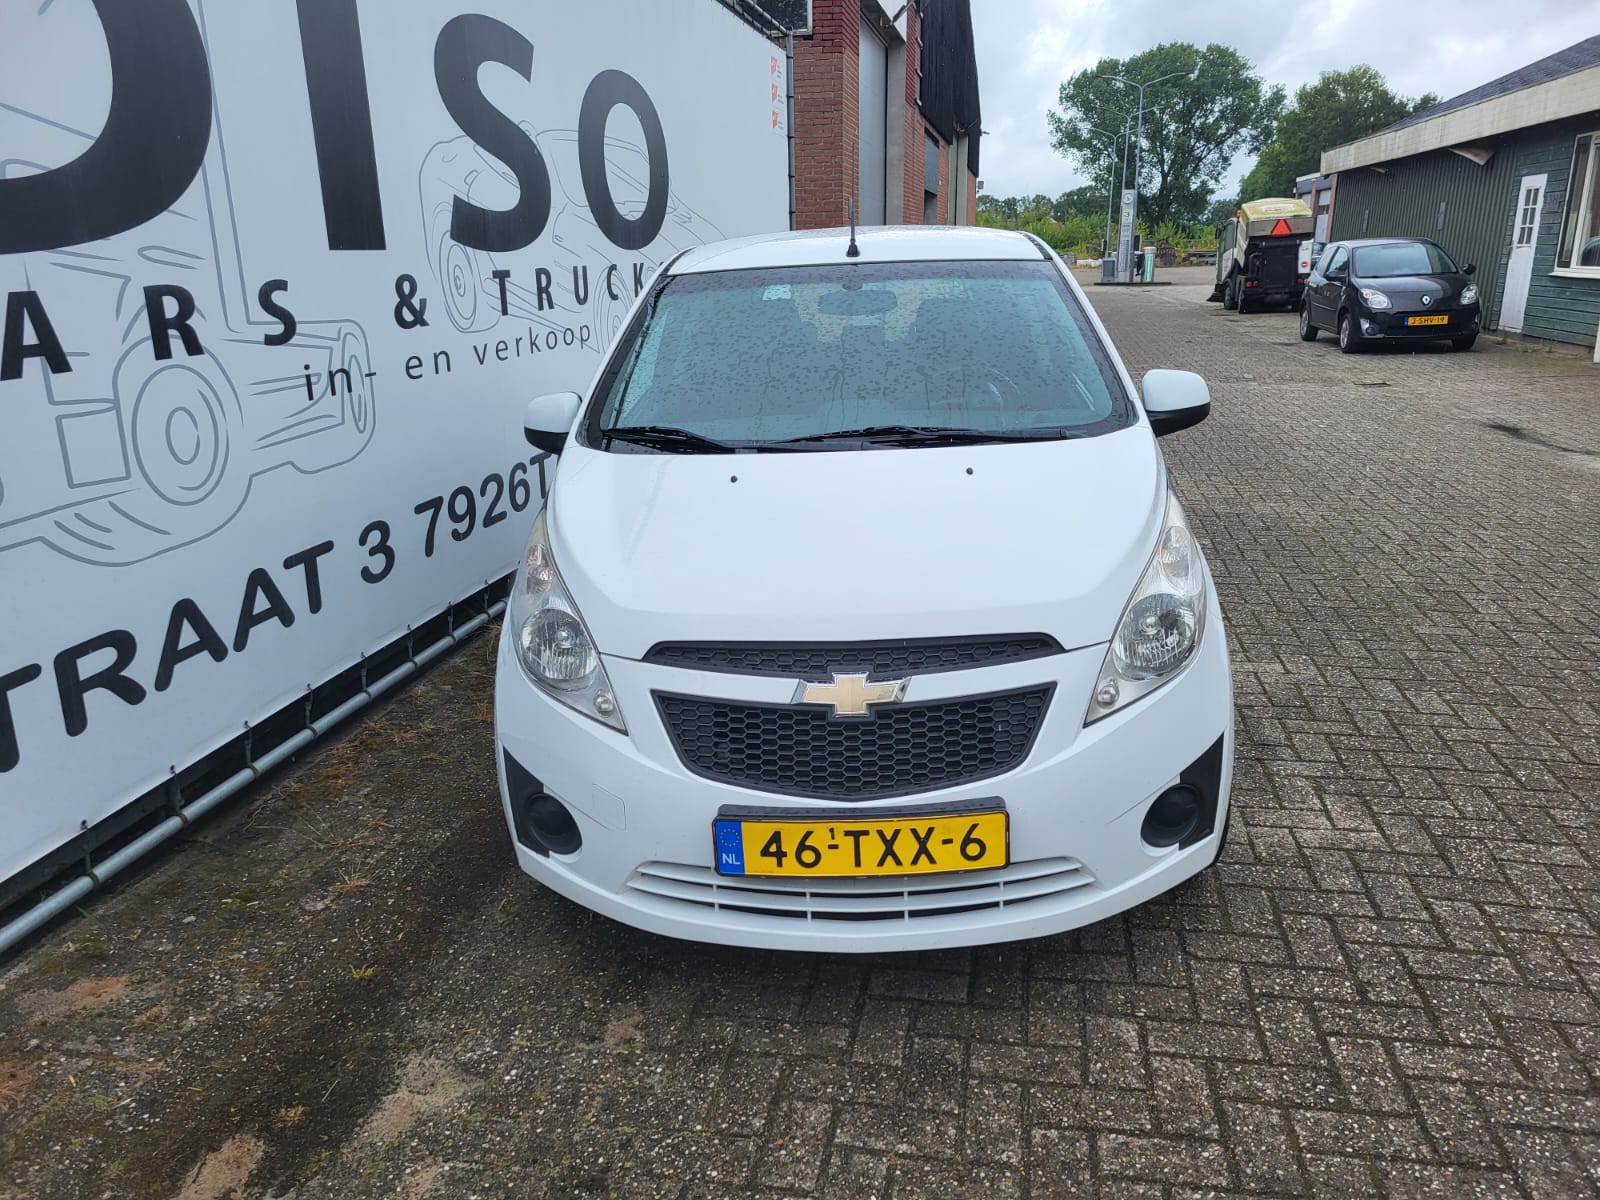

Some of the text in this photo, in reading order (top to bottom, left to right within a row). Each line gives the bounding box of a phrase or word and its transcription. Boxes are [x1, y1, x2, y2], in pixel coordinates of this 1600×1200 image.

[394, 273, 430, 330] &
[492, 261, 665, 317] TRUCK
[304, 324, 591, 401] in- en verkoop
[358, 520, 396, 585] 3
[722, 853, 741, 865] NL
